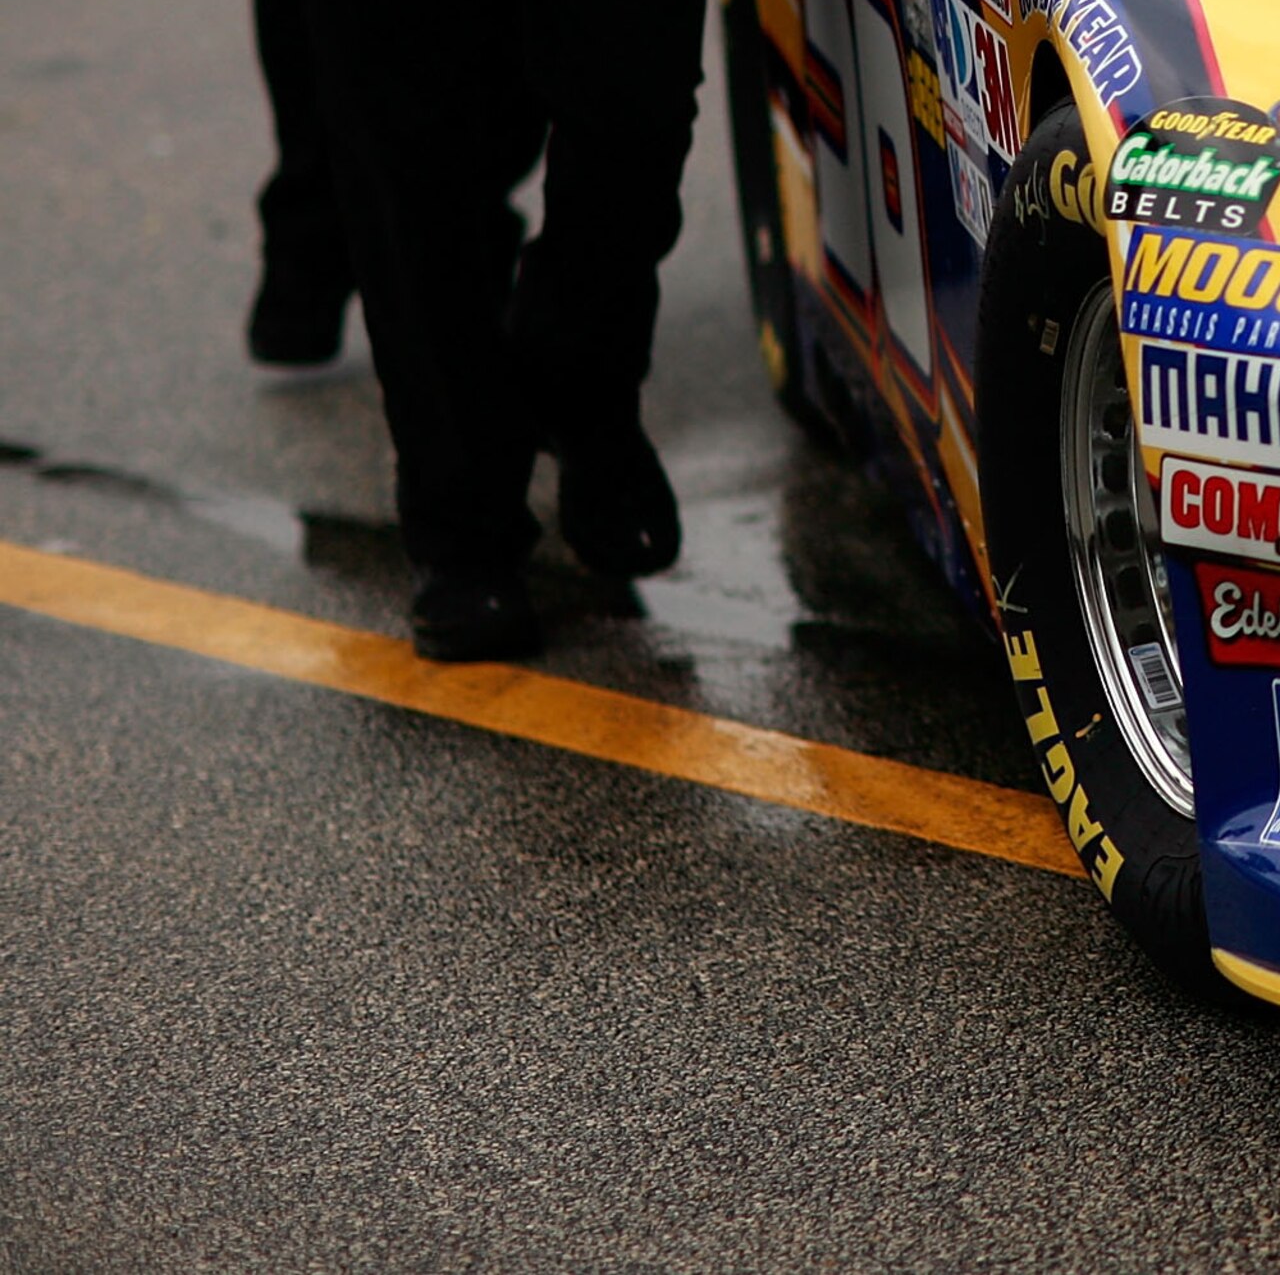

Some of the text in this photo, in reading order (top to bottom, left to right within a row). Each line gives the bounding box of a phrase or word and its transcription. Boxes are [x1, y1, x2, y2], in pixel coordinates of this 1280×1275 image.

[975, 22, 1022, 159] 3M
[1149, 110, 1277, 146] GOODYEAR
[1110, 131, 1280, 202] Gatorback
[1110, 190, 1246, 228] BELTS
[1128, 300, 1219, 342] CHASSIS
[1002, 629, 1125, 906] EAGLE
